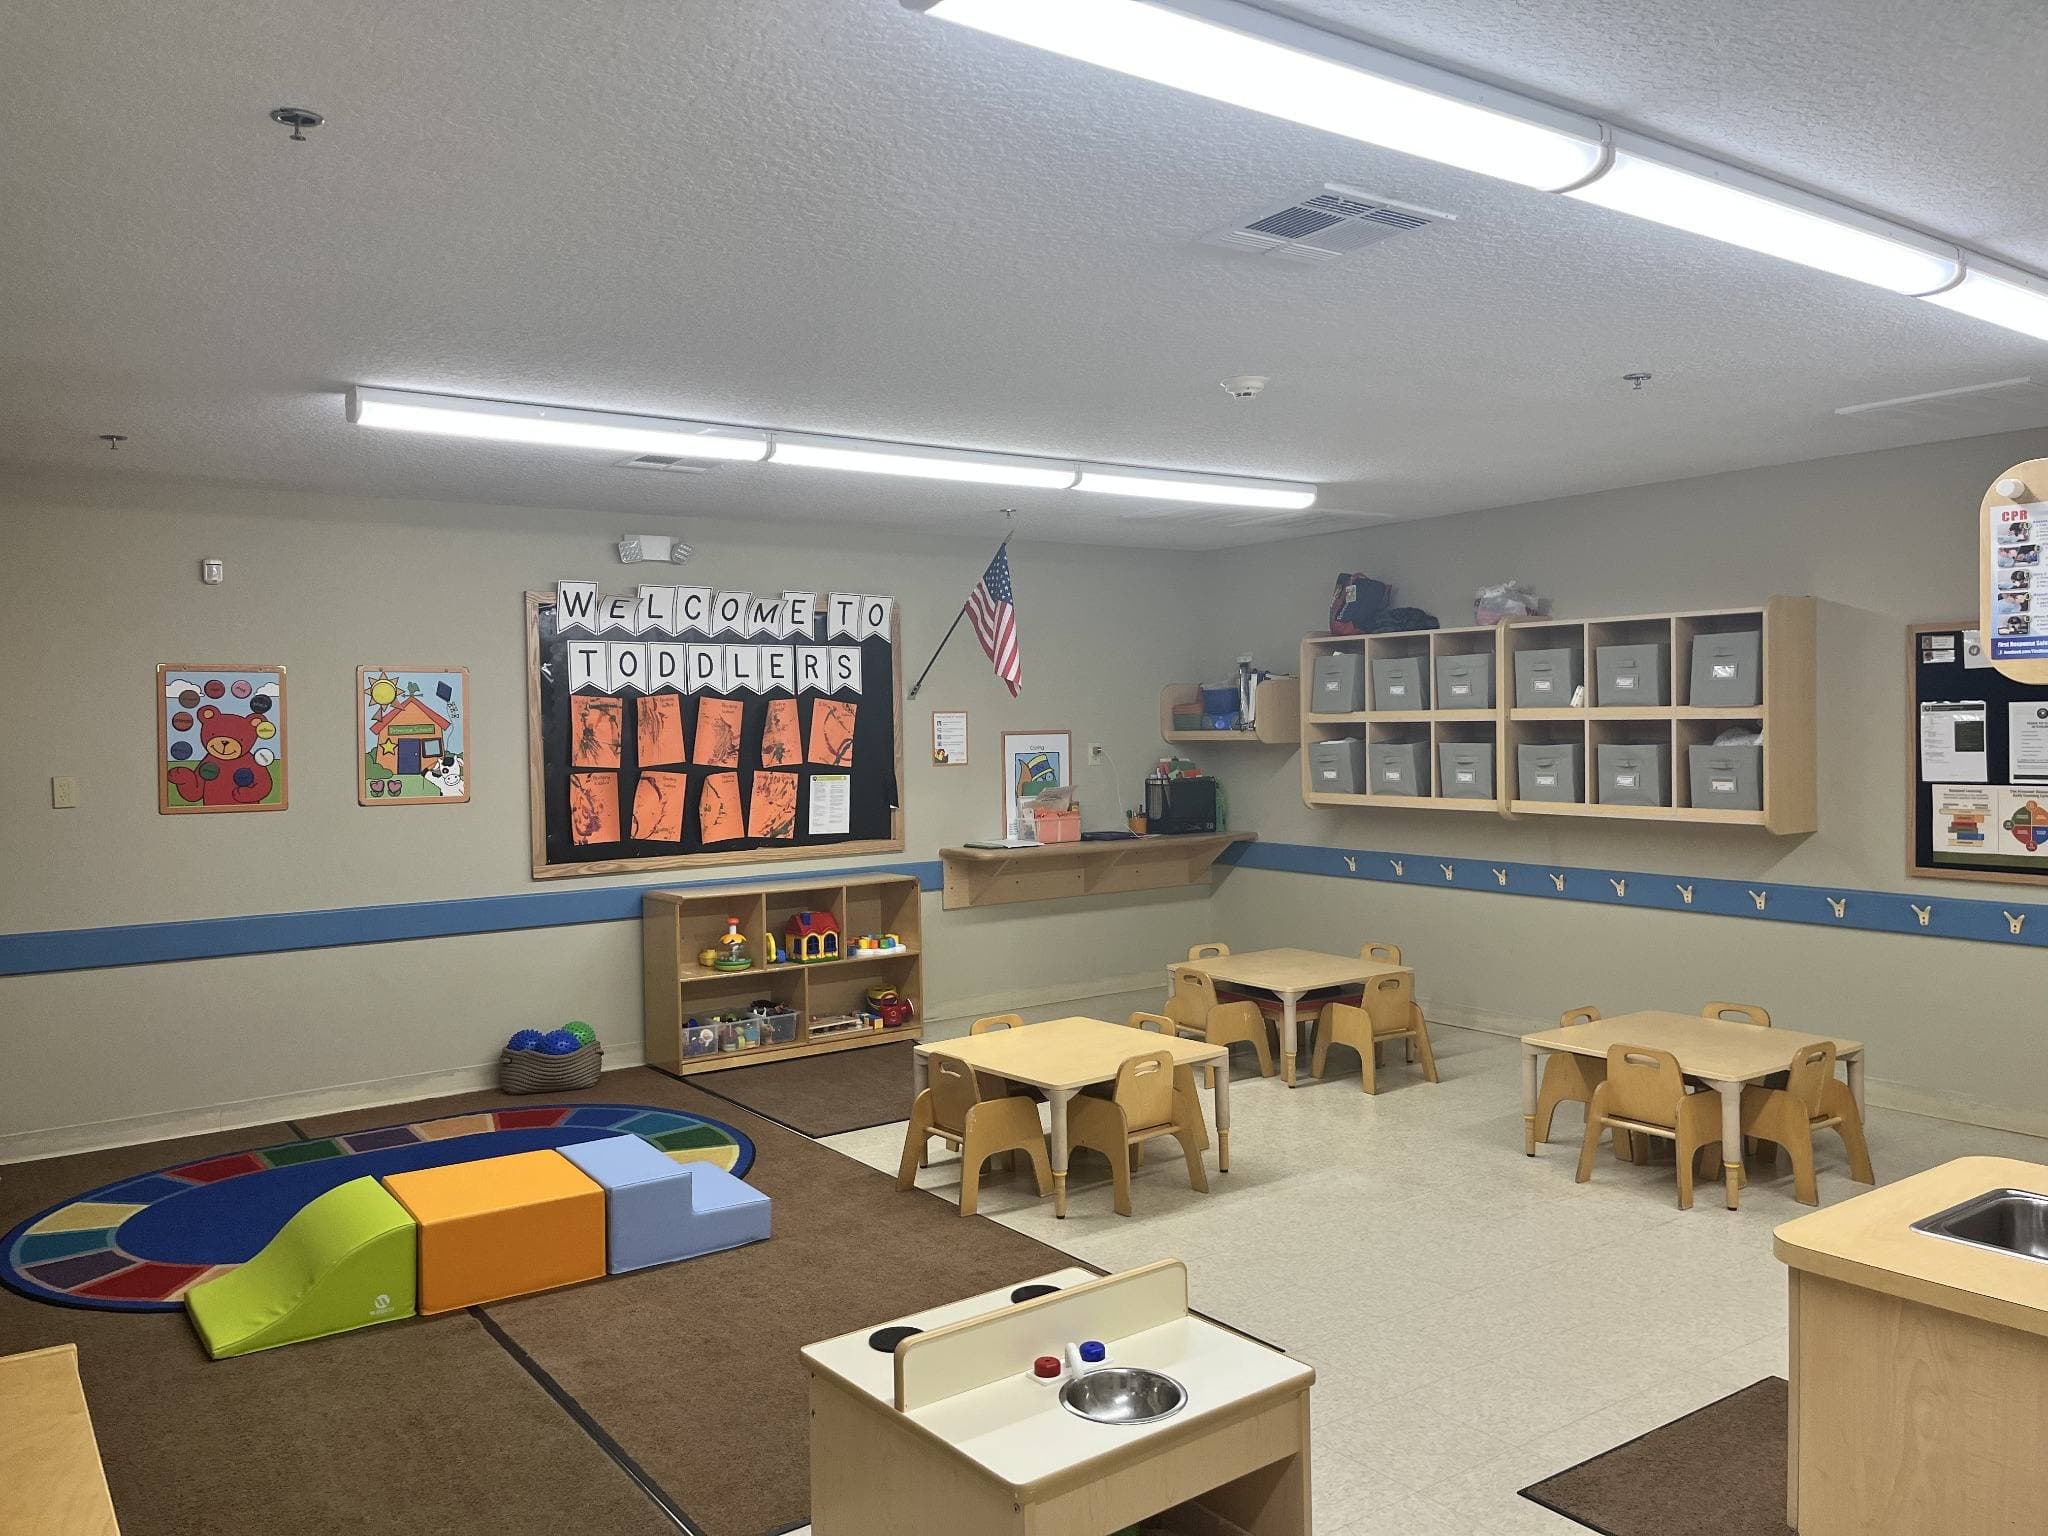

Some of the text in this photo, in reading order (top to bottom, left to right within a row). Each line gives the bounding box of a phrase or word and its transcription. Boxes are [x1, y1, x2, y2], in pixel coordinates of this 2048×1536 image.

[2001, 510, 2028, 522] CPR
[562, 589, 884, 627] WELCOME TO
[577, 650, 853, 680] TODDLERS
